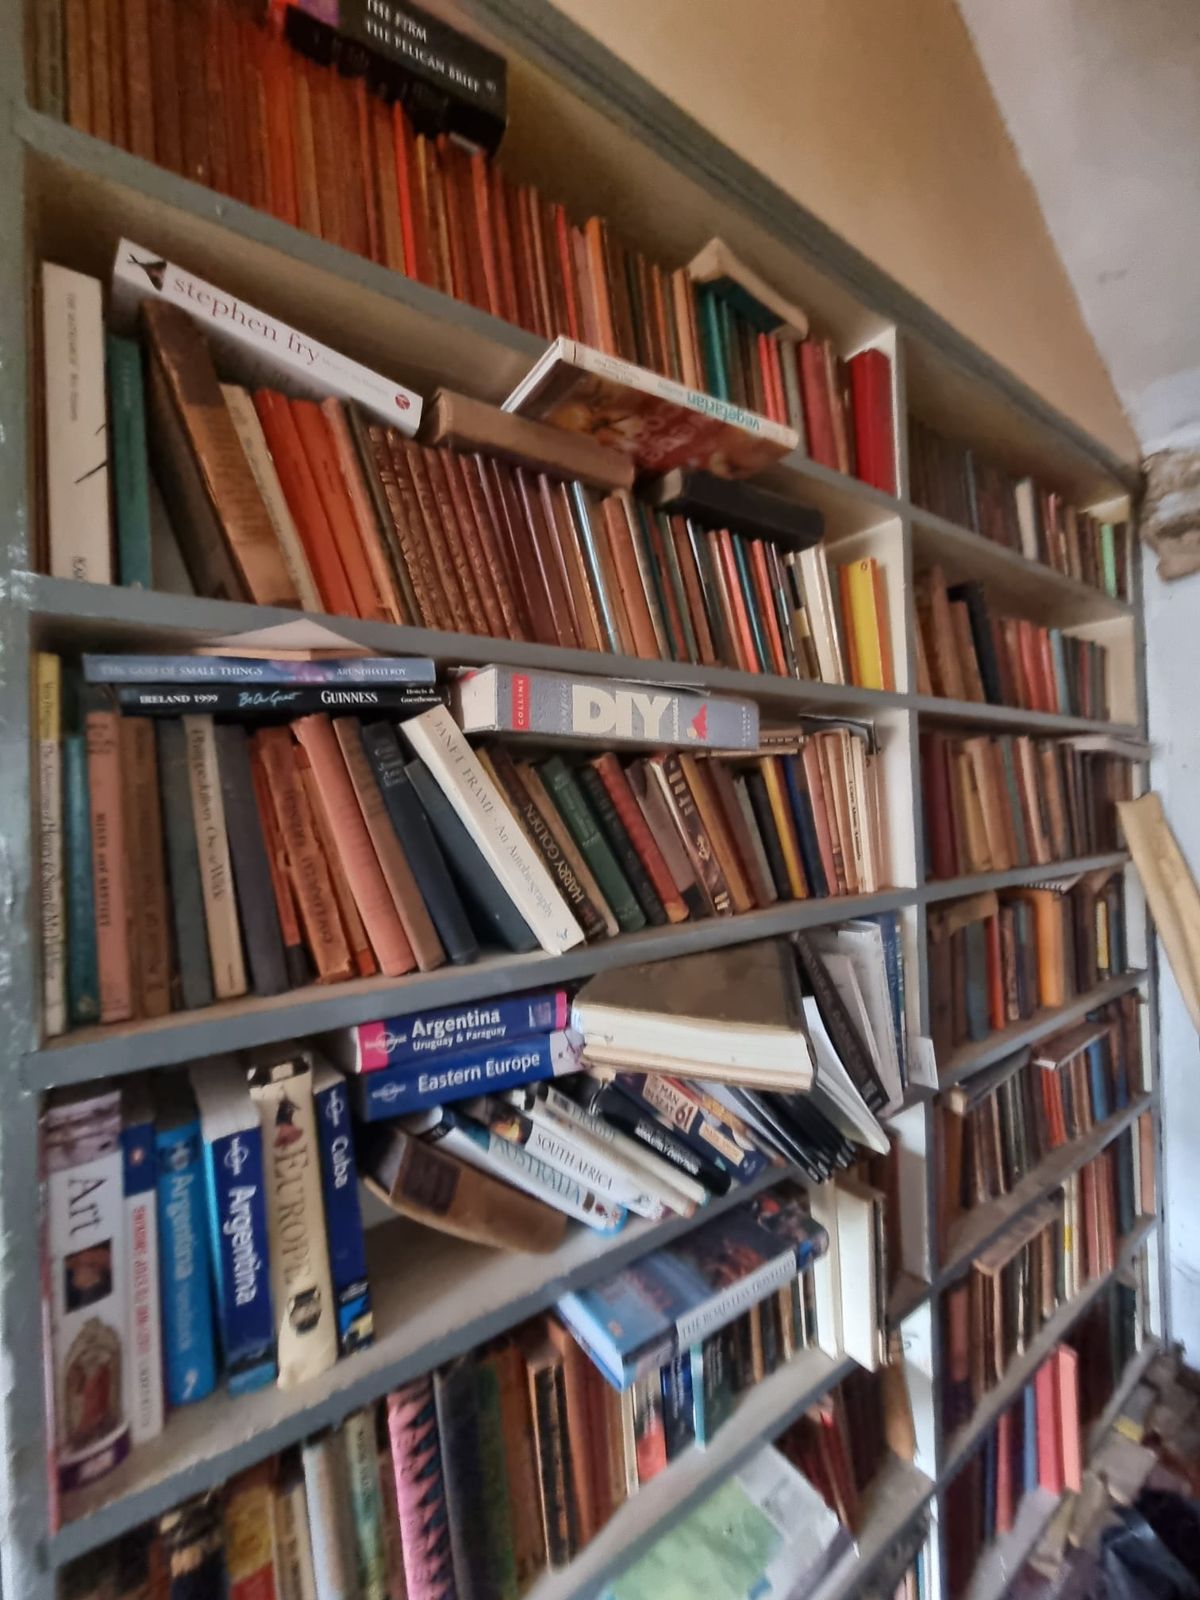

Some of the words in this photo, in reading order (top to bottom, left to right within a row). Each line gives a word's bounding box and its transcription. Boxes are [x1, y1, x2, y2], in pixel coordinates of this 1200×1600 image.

[395, 11, 427, 43] FIRM
[395, 34, 445, 74] PELICAN
[449, 64, 480, 93] BRIEF
[174, 276, 278, 342] stephen
[287, 333, 320, 366] fry
[140, 694, 191, 704] IRELAND
[193, 693, 219, 704] 1999
[320, 689, 378, 705] GUINNESS
[179, 665, 216, 676] SMALL
[219, 665, 263, 676] THINGS
[388, 667, 407, 676] ROY
[517, 679, 525, 726] COLLINS
[572, 684, 672, 739] DIY
[434, 720, 466, 764] JANET
[462, 767, 495, 815] FRAME
[507, 844, 553, 917] Autobiography
[523, 804, 561, 860] GOLDEN
[554, 858, 585, 904] HARRY
[411, 1008, 501, 1039] Argentina
[412, 1037, 454, 1052] Uruguay
[456, 1034, 464, 1043] &
[466, 1025, 507, 1042] Paraguay
[417, 1068, 481, 1094] Eastern
[486, 1052, 541, 1078] Europe
[674, 1101, 694, 1132] 61
[330, 1136, 350, 1190] Cuba
[492, 1134, 583, 1206] AUSTRALIA
[535, 1132, 573, 1166] SOUTH
[571, 1159, 614, 1191] AFRICA
[68, 1177, 109, 1236] Art
[167, 1174, 194, 1280] Argentina
[274, 1145, 313, 1290] EUROPE
[222, 1184, 261, 1306] Argentina
